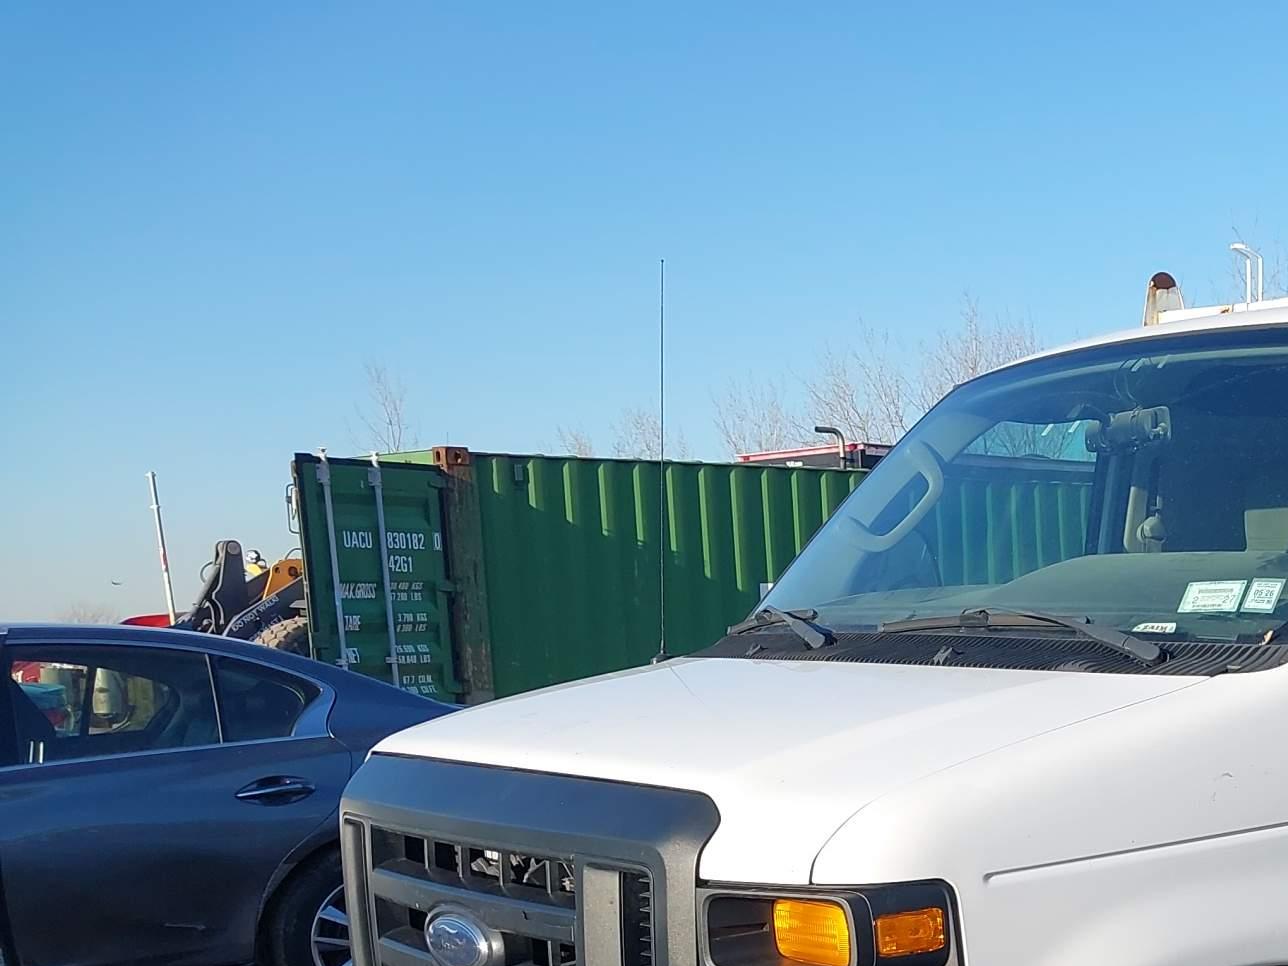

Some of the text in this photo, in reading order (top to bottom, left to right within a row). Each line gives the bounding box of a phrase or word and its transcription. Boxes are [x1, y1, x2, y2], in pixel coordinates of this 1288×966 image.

[343, 531, 373, 549] UACU
[387, 532, 425, 550] 830182
[388, 555, 413, 573] 42G1
